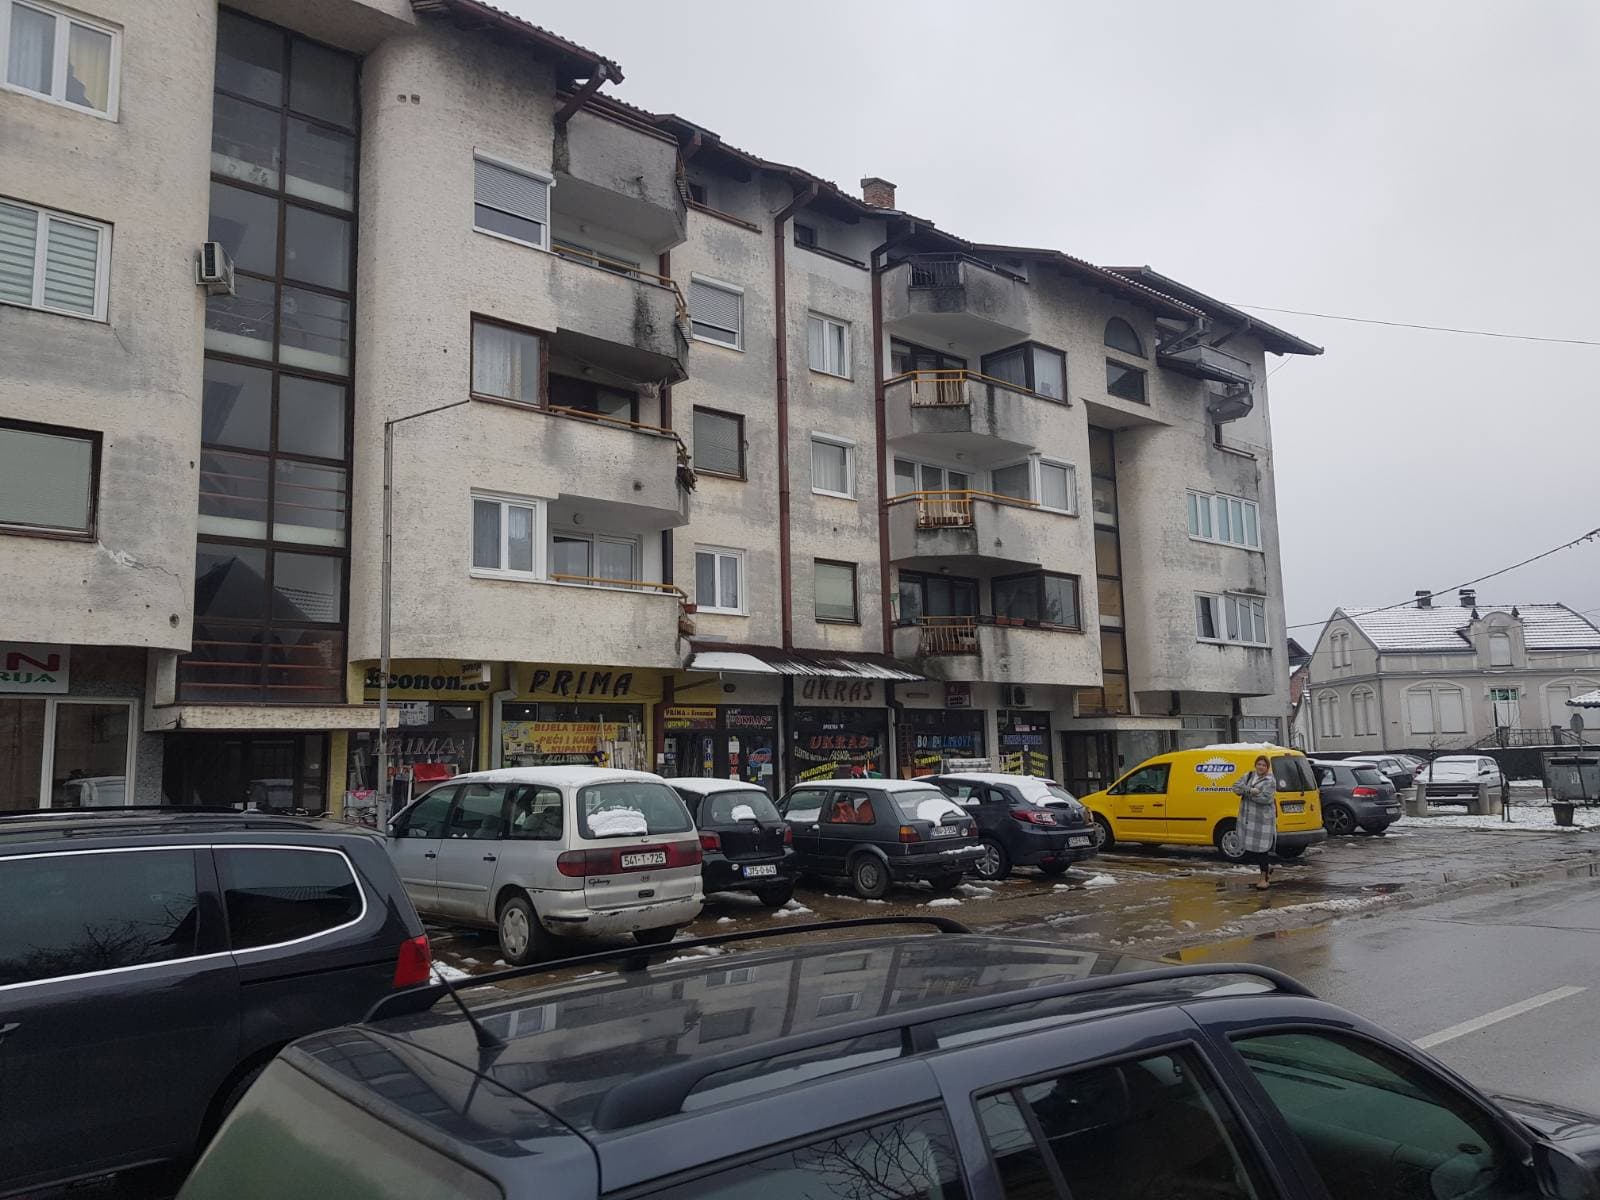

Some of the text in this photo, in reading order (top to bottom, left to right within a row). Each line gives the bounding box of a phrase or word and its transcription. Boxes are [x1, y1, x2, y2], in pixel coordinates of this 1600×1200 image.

[364, 668, 490, 690] Economc
[528, 670, 633, 697] PRIMA
[802, 679, 874, 702] UKRAS
[624, 853, 664, 866] 541-T-725
